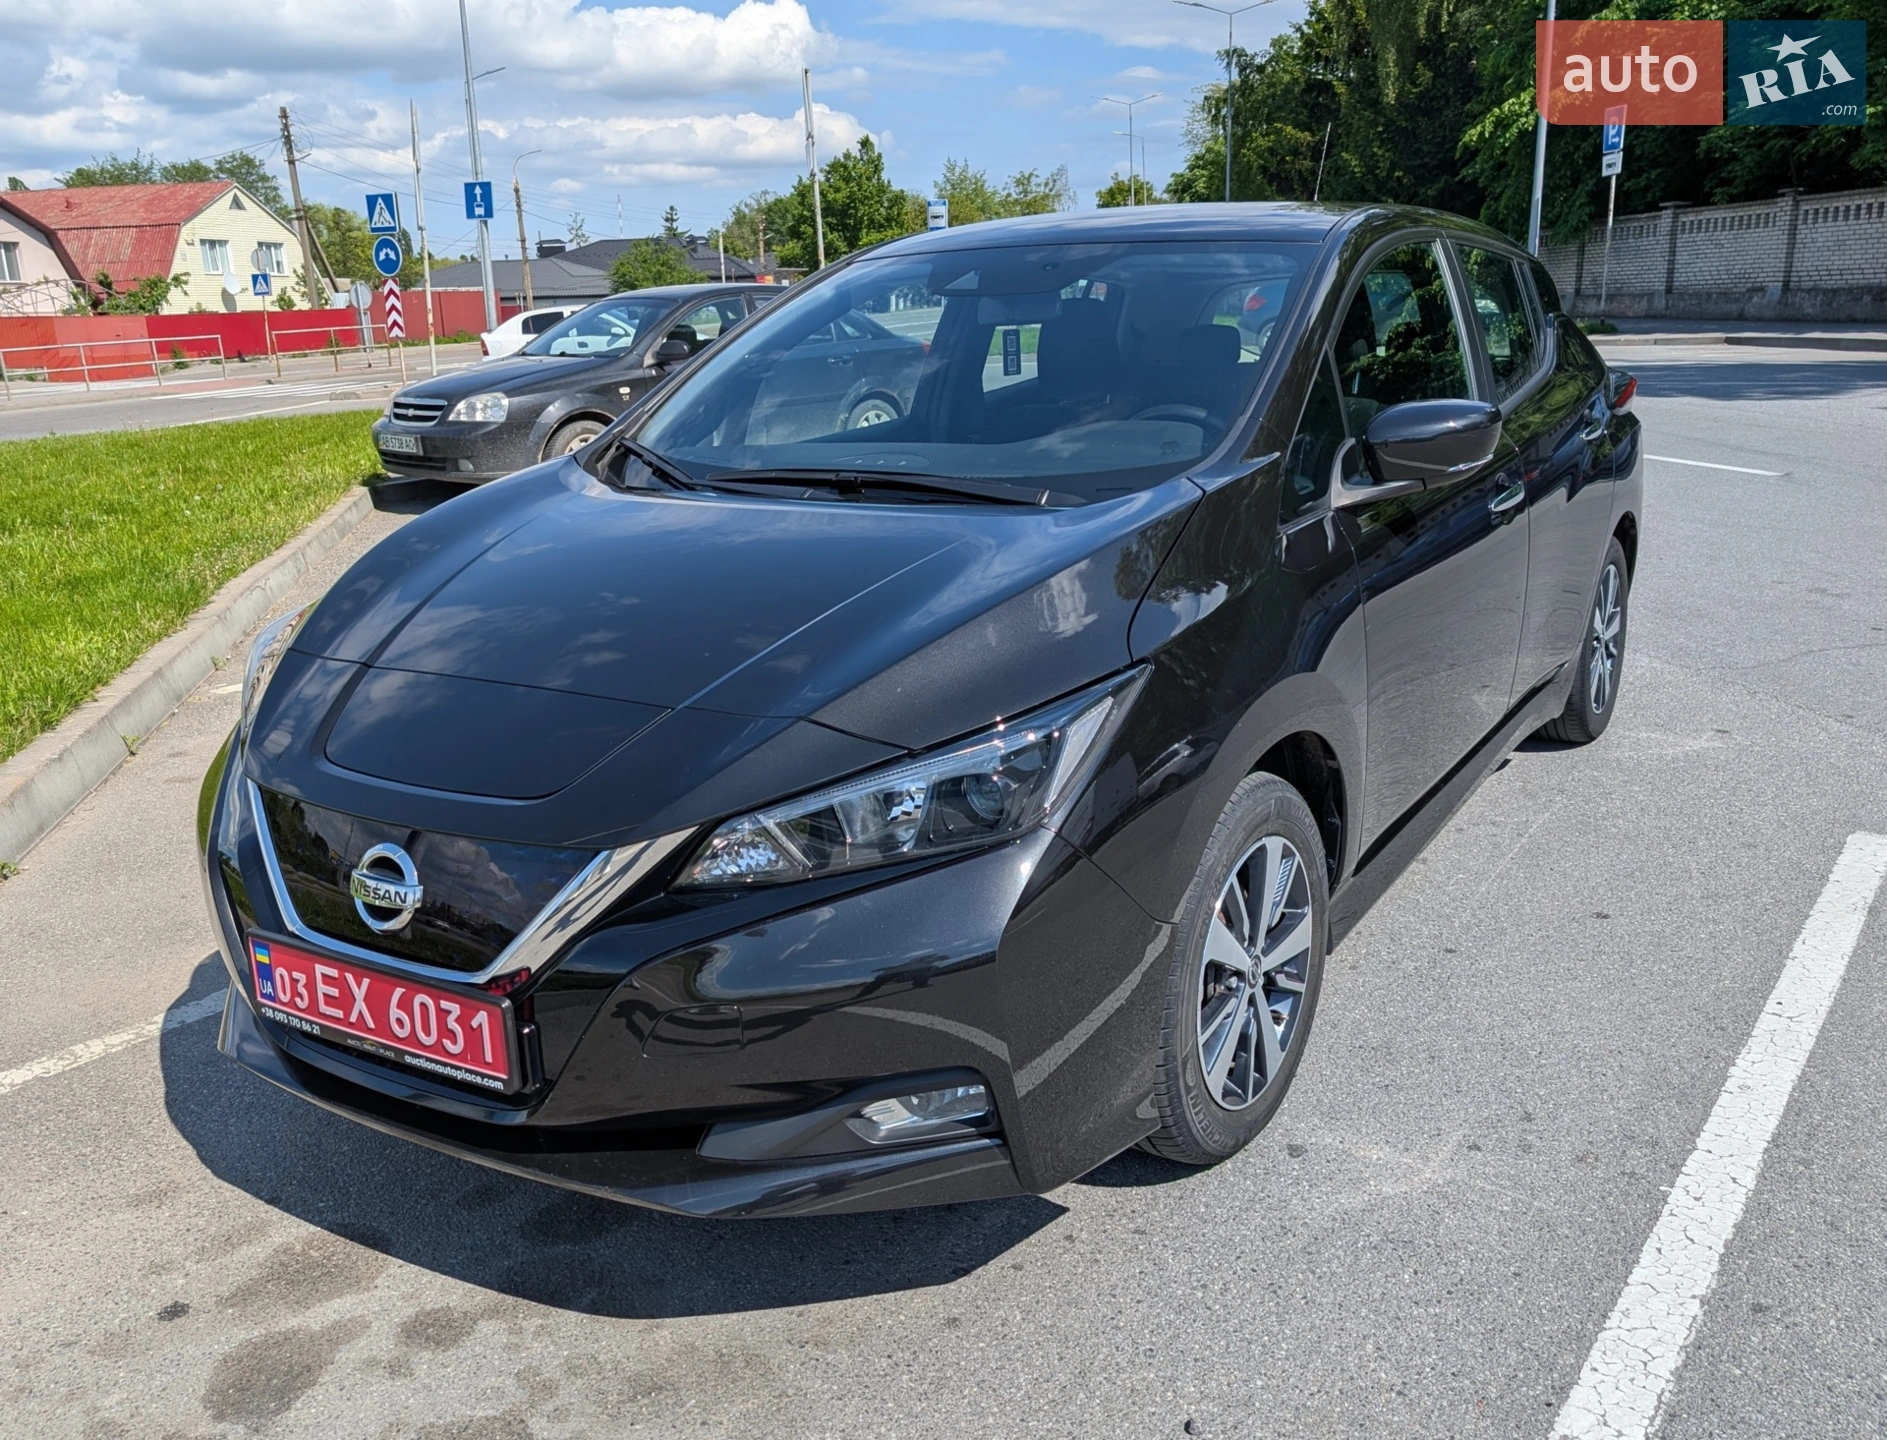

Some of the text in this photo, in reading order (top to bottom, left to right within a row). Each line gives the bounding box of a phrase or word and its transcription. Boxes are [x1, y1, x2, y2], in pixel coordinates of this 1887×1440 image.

[351, 877, 408, 905] NISSAN
[259, 977, 275, 997] UA
[261, 1006, 321, 1036] +38 093 170 86 21
[275, 963, 493, 1064] 03 EX 6031
[404, 1053, 504, 1091] auctionautoplace.com
